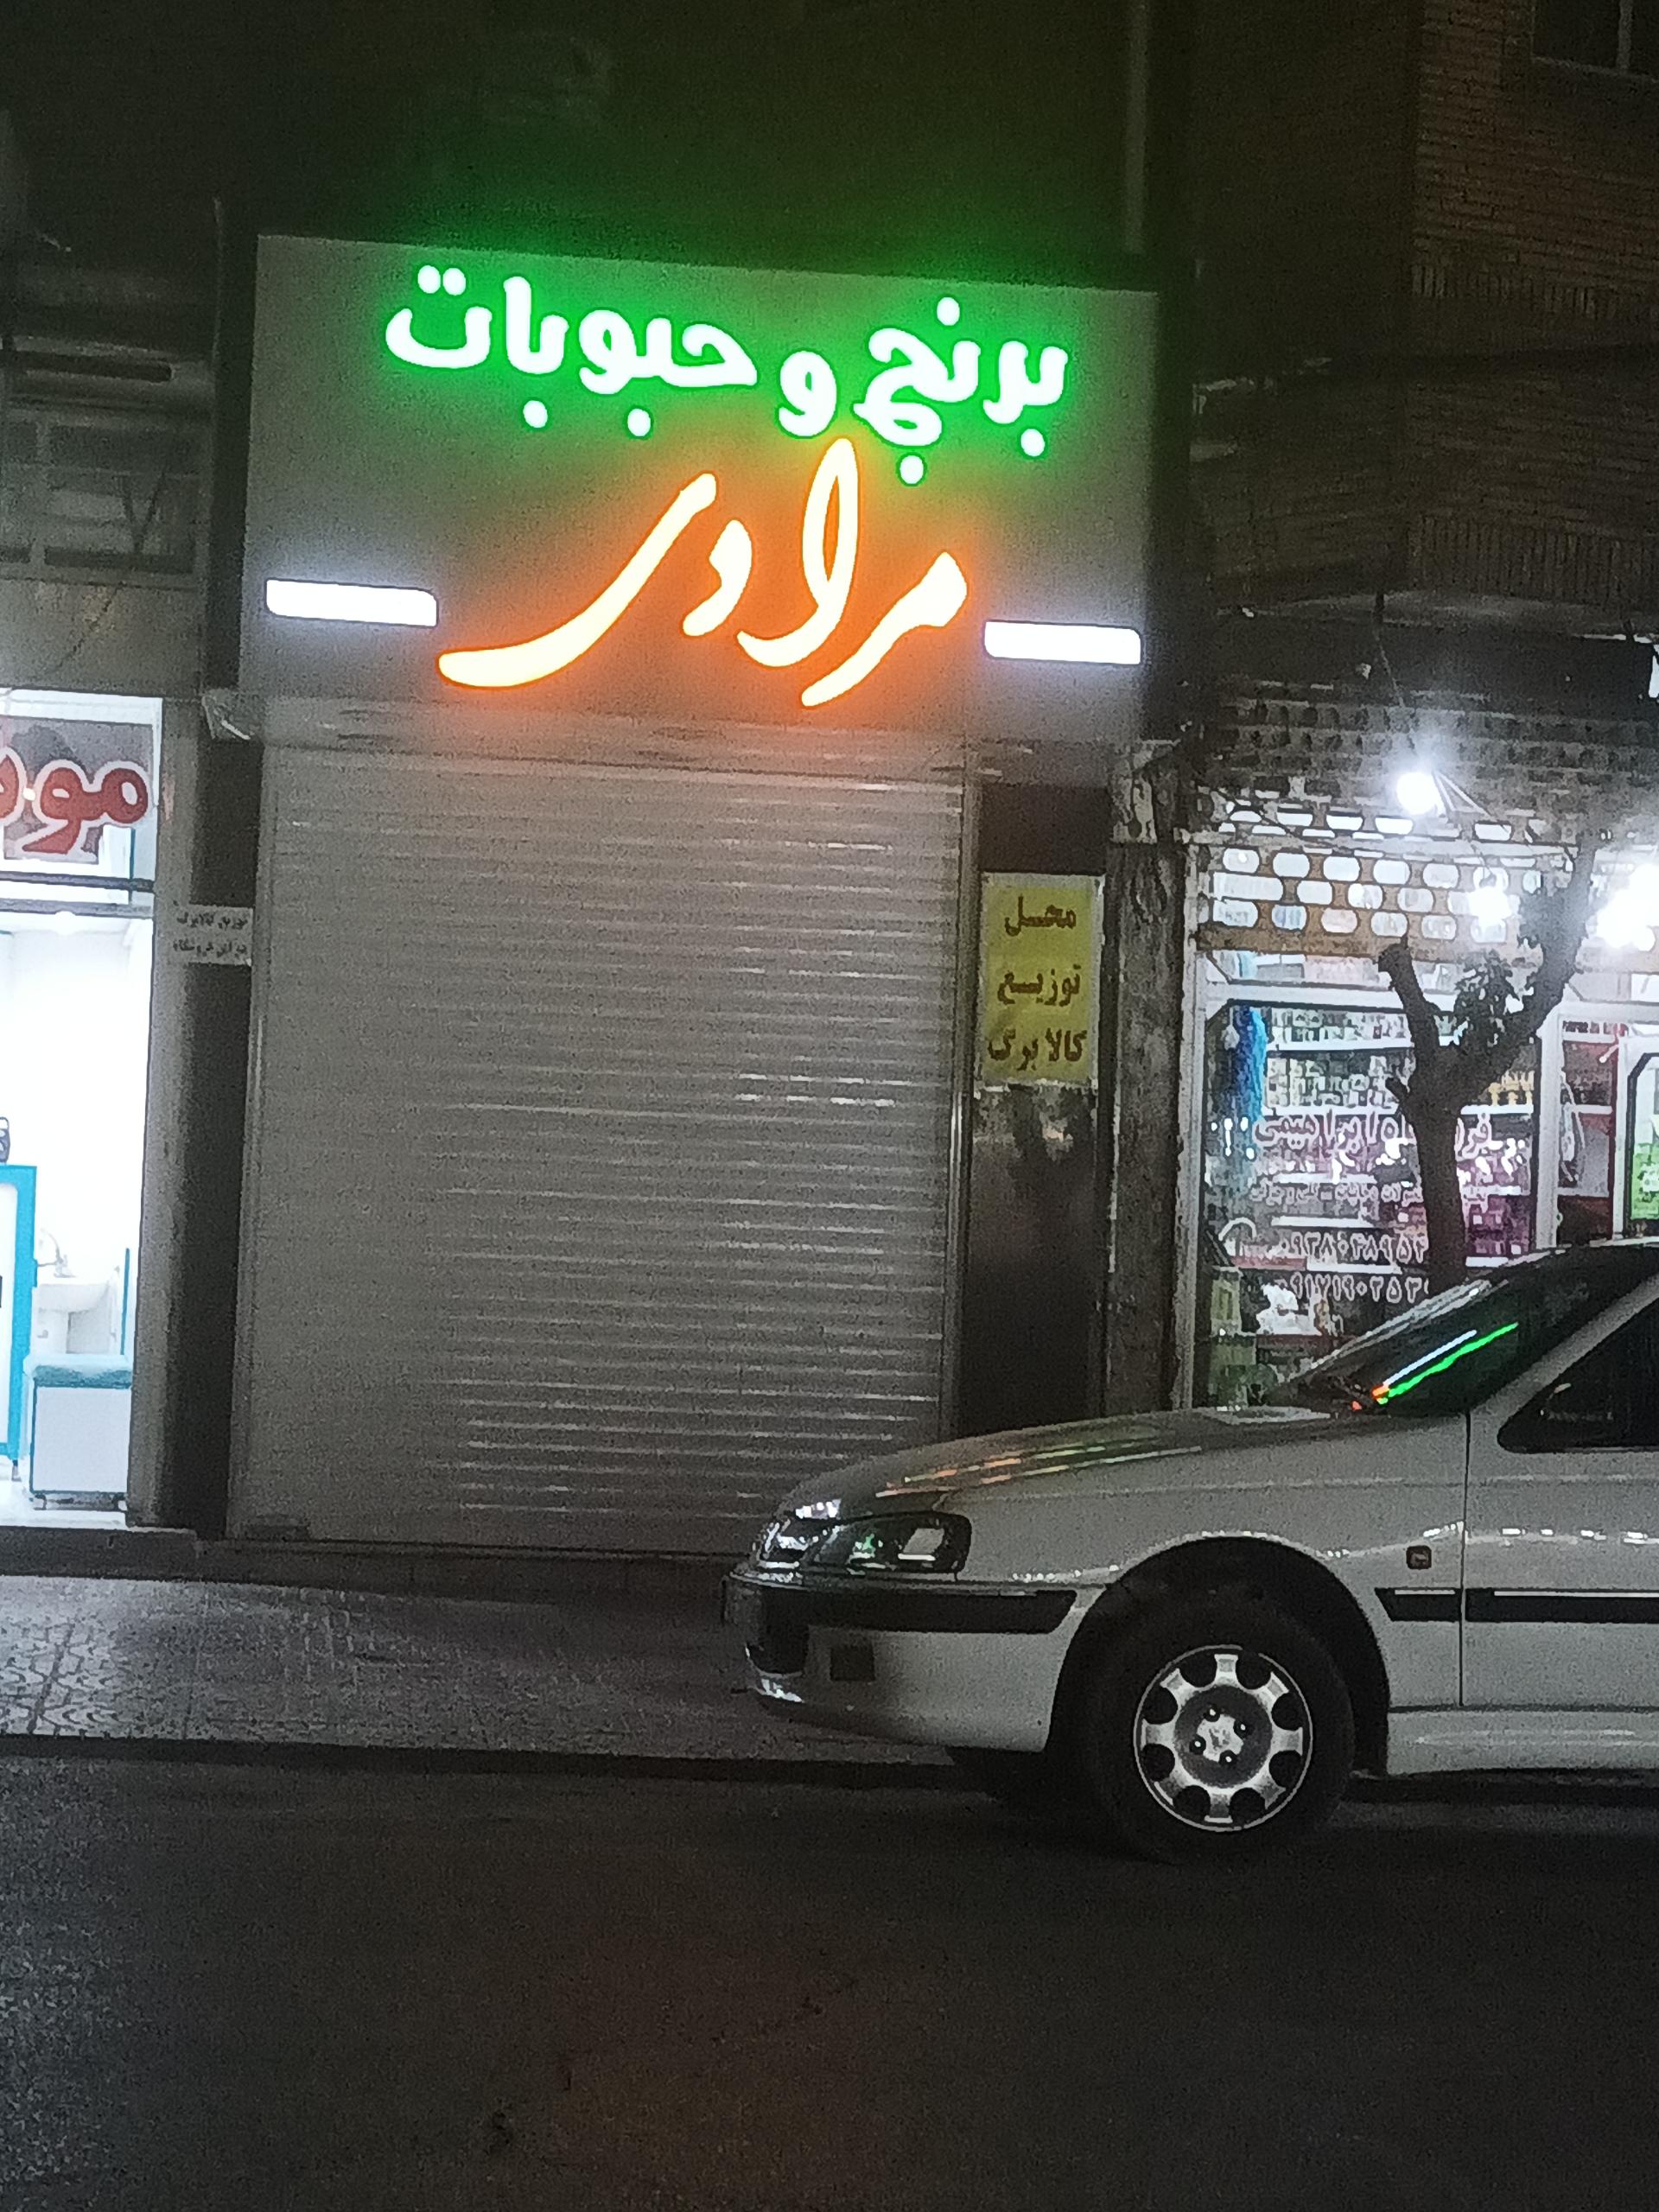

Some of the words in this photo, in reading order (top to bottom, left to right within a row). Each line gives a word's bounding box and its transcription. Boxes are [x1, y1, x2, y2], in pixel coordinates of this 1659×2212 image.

[385, 264, 758, 438] حبوبات
[778, 350, 838, 438] و
[852, 296, 1070, 486] برنج
[1004, 894, 1077, 937] محل
[997, 963, 1081, 1007] توزیع
